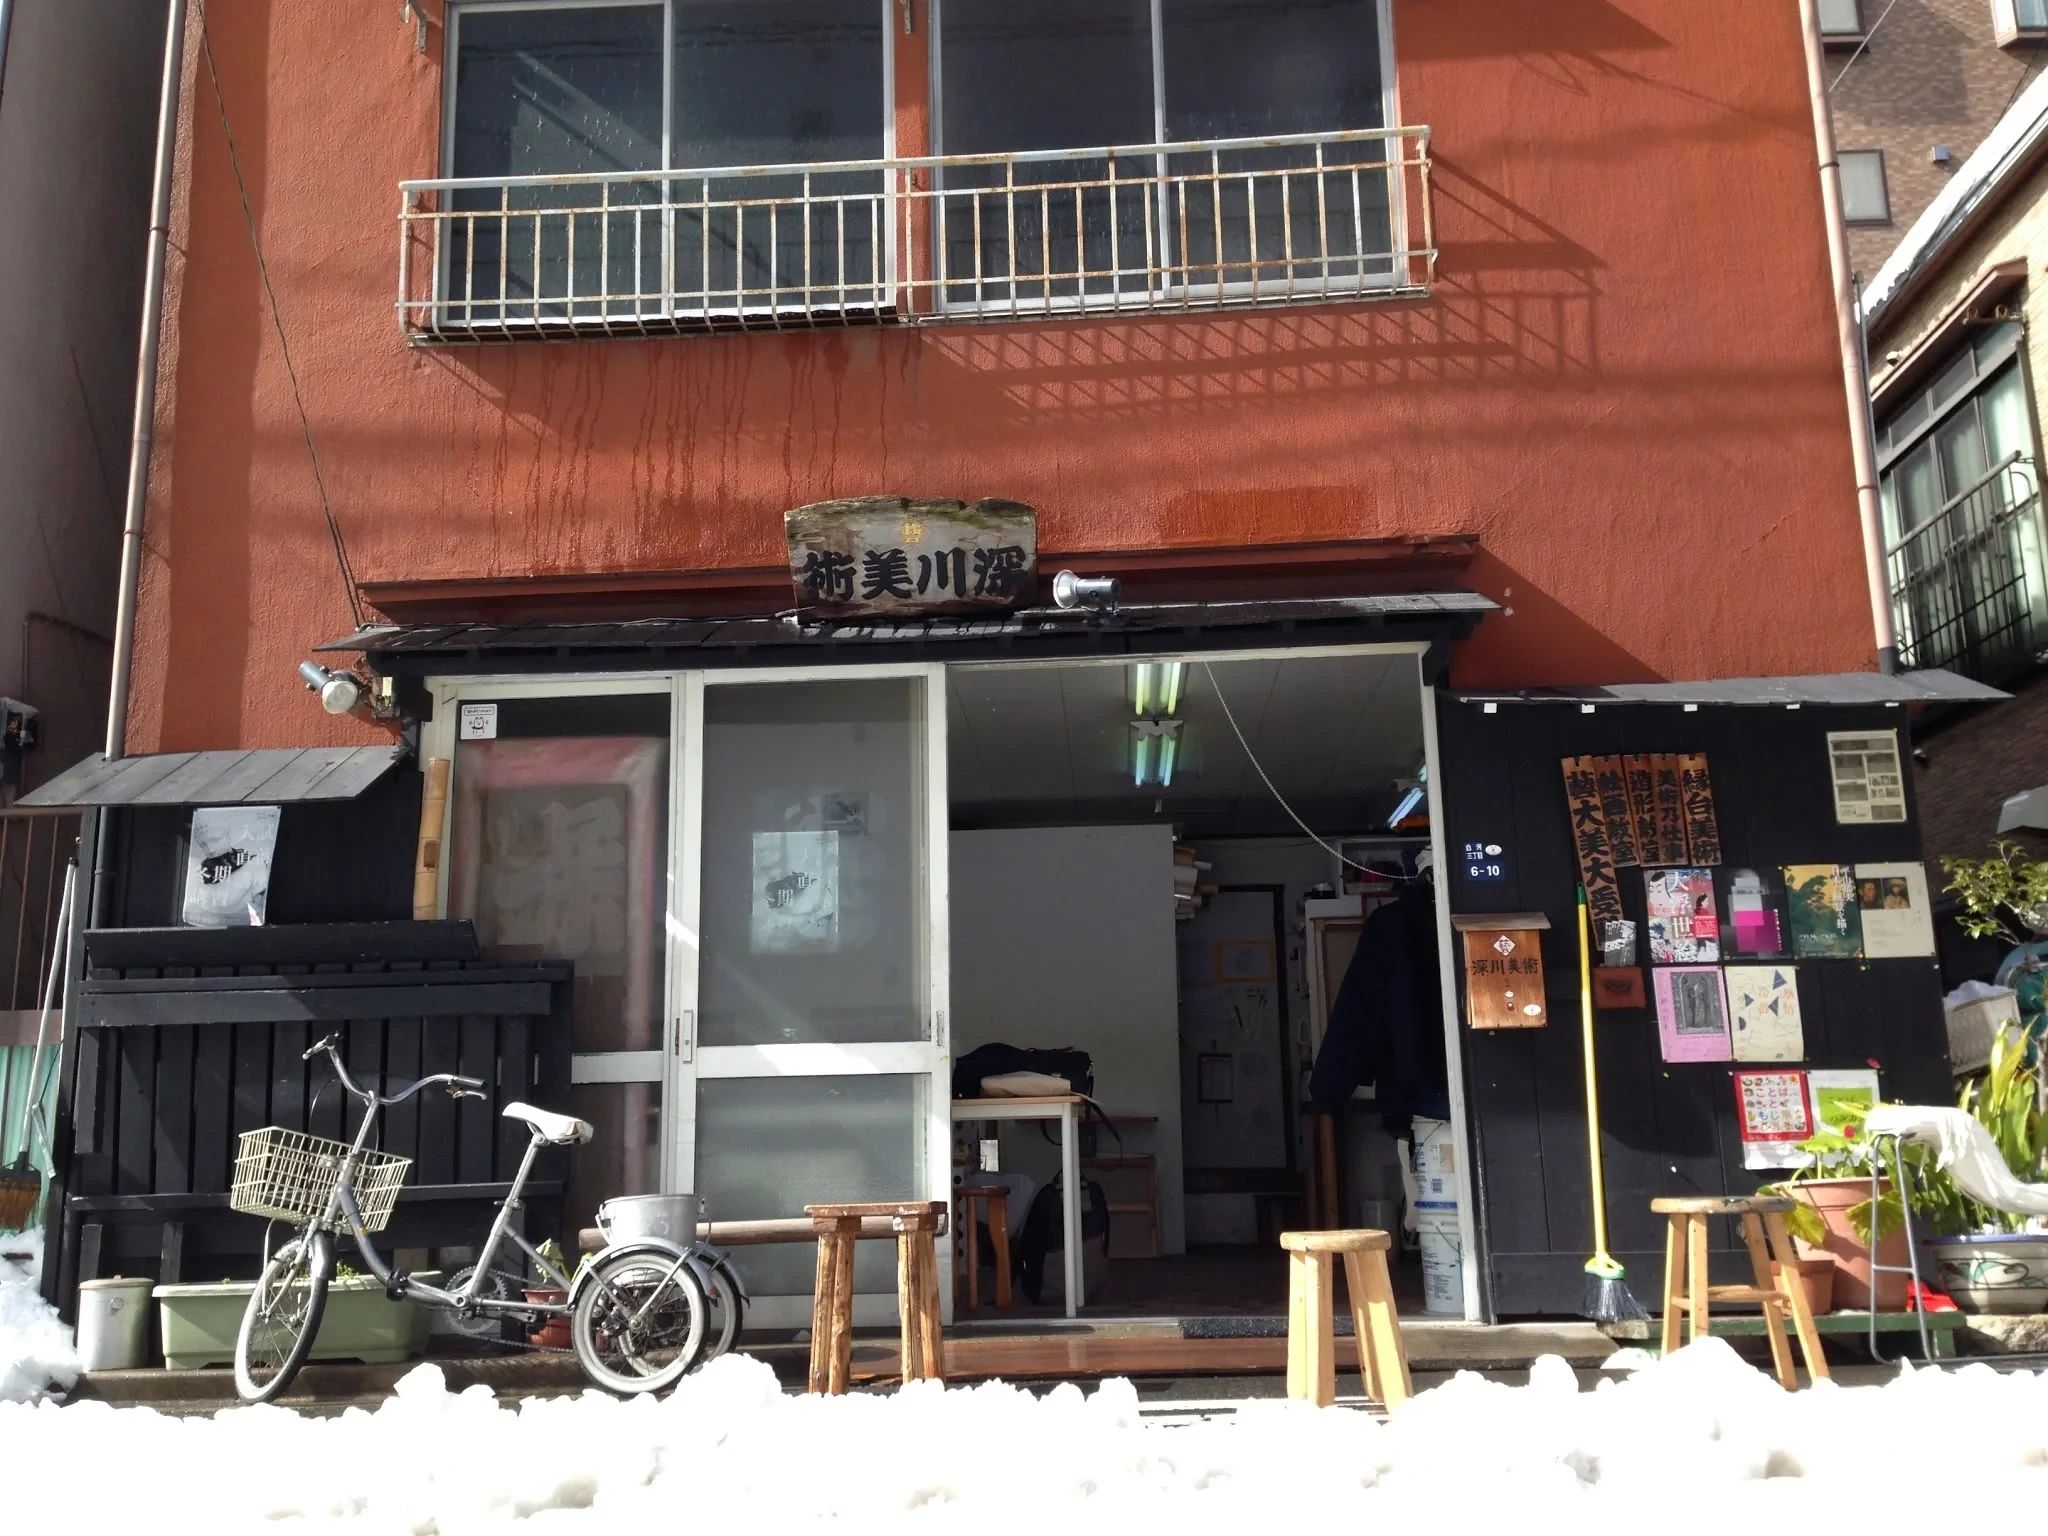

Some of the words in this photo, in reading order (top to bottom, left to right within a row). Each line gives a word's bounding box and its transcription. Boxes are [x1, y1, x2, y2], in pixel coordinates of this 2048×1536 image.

[1471, 865, 1500, 877] 6-10
[1472, 958, 1539, 976] 深川美術
